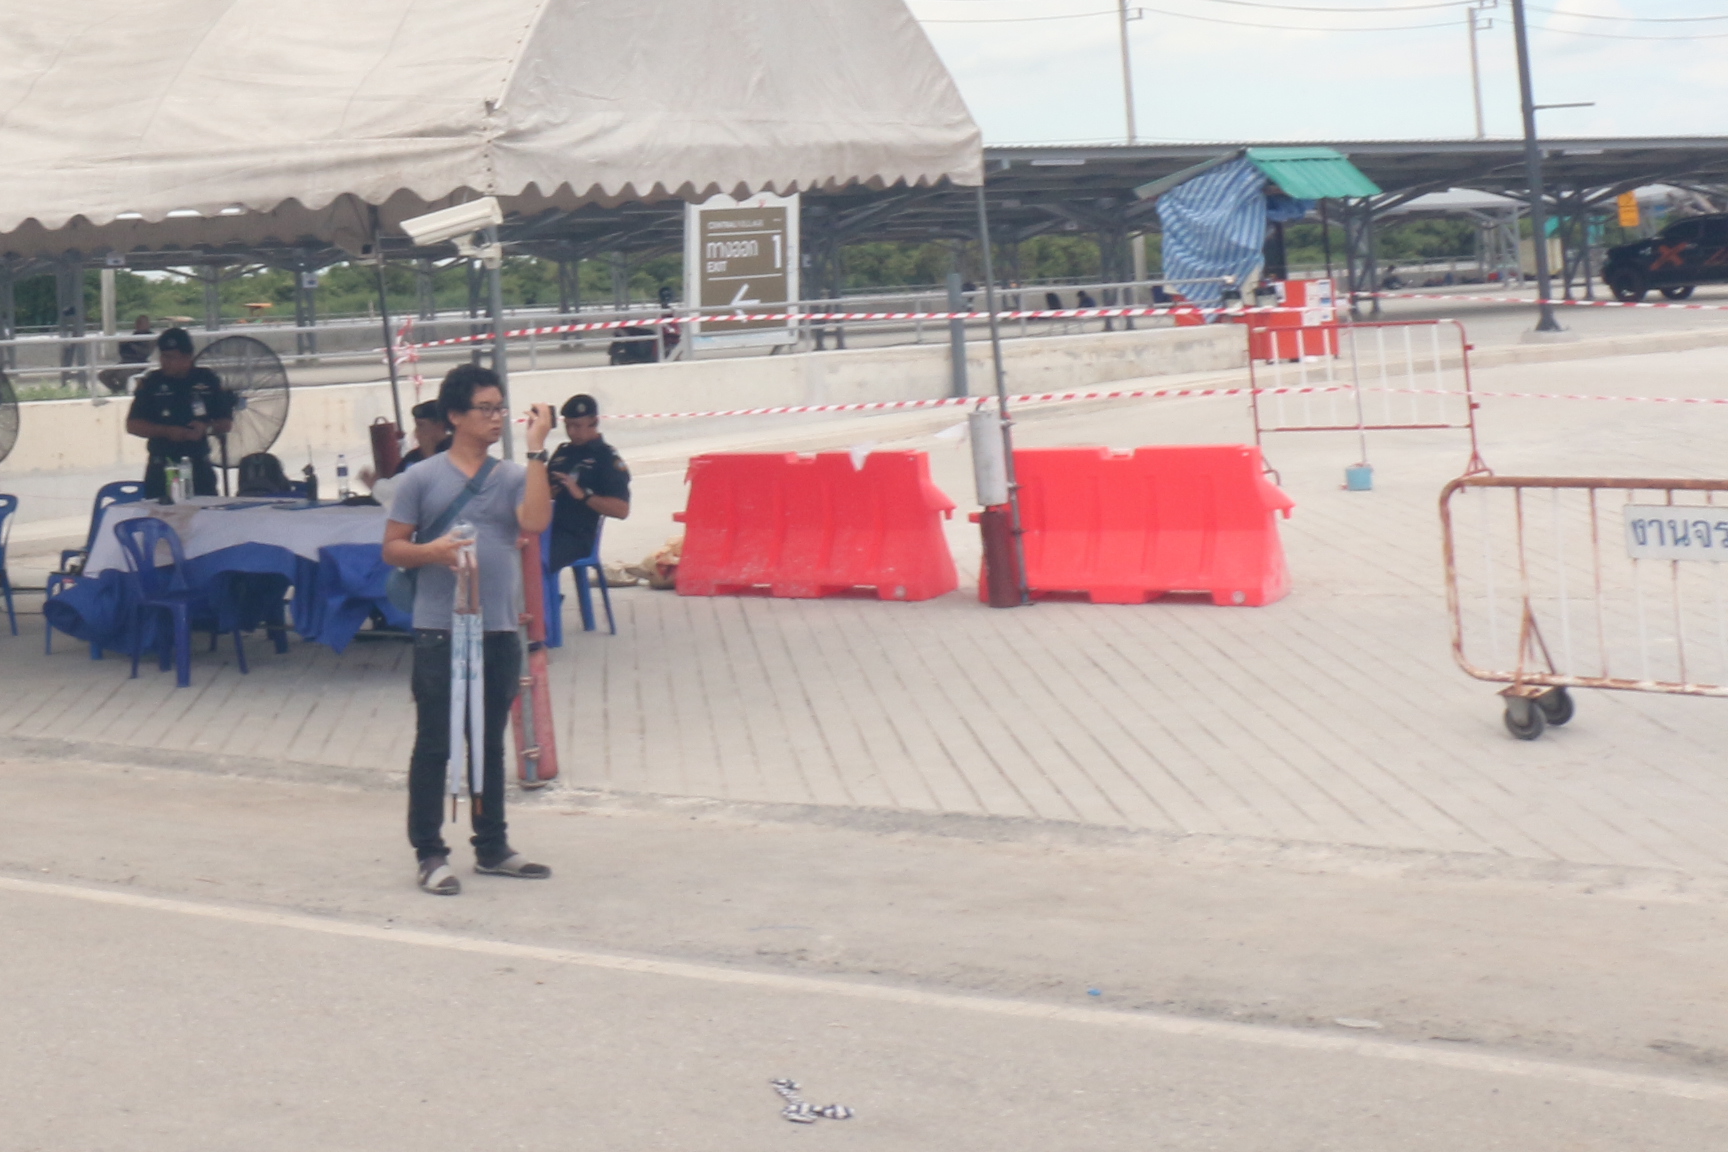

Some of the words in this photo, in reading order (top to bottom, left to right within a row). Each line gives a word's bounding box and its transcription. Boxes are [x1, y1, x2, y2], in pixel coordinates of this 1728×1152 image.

[706, 239, 759, 259] ทางออก
[772, 234, 782, 269] 1
[706, 260, 728, 273] EXIT
